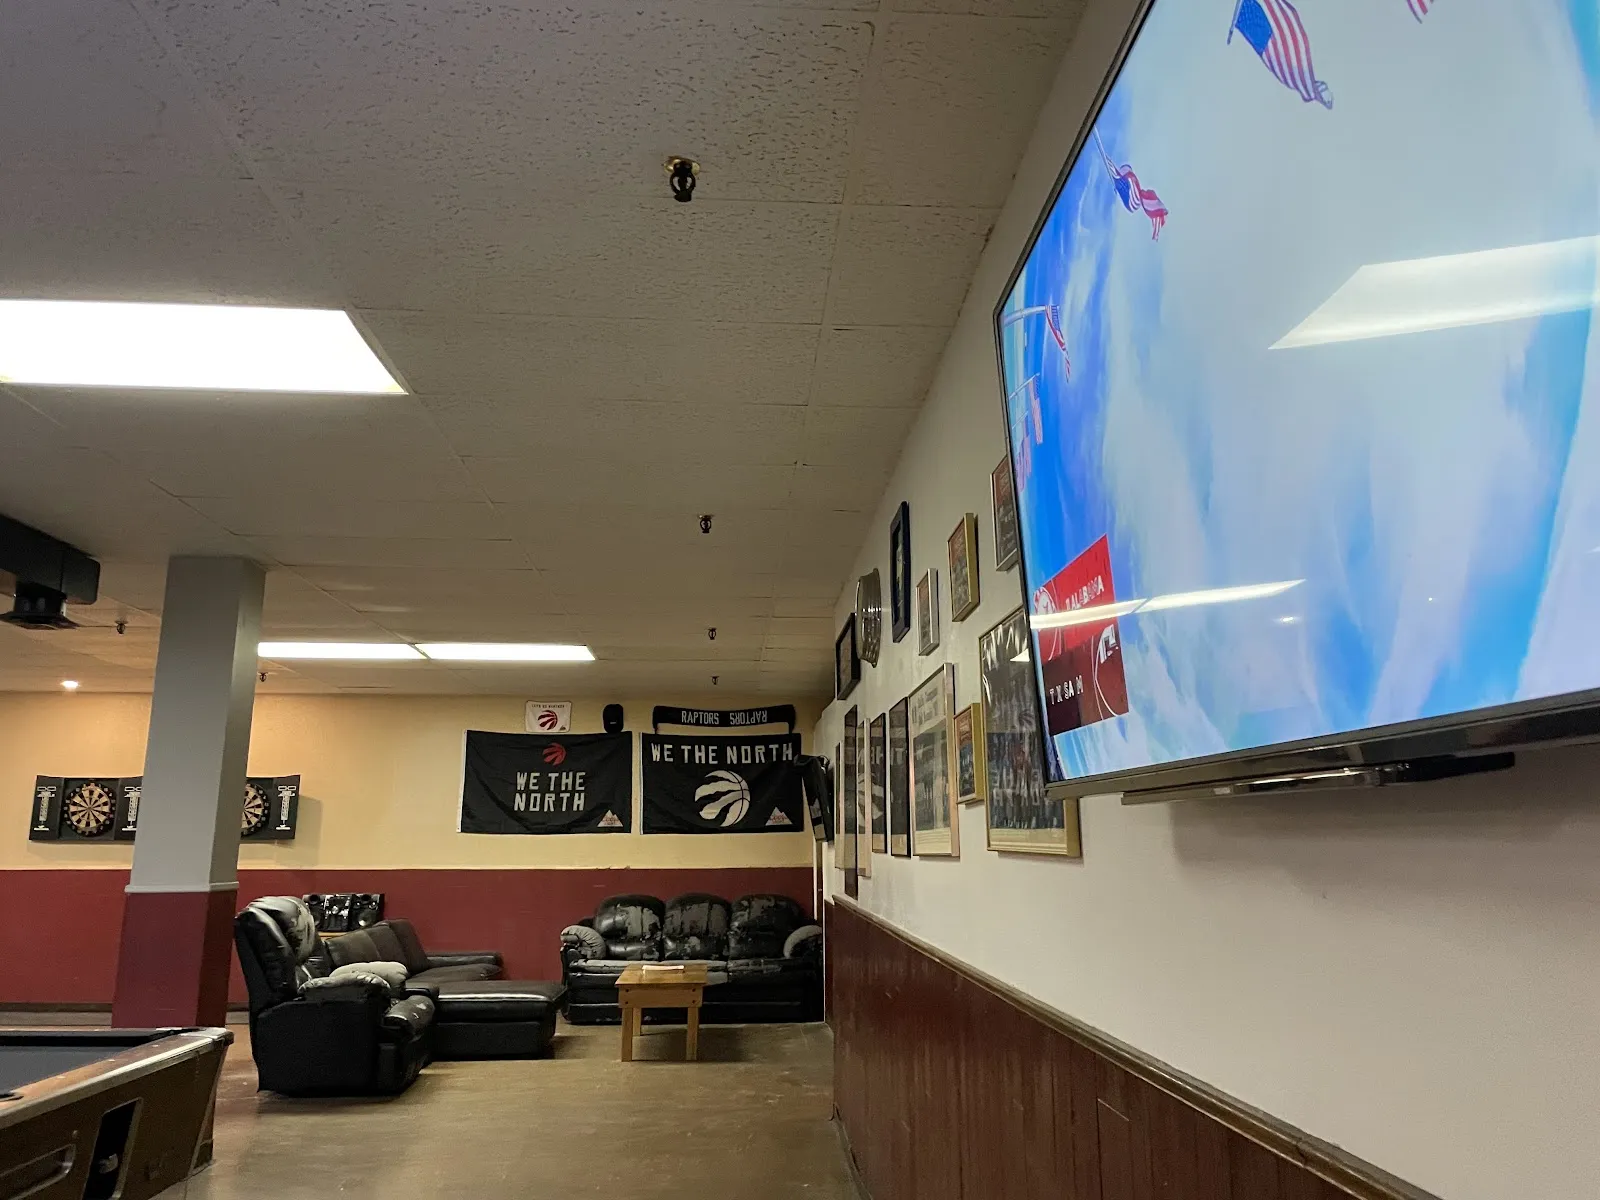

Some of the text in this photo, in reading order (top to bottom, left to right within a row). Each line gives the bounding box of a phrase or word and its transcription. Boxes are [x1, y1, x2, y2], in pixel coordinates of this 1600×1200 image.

[681, 710, 720, 725] RAPTORS
[729, 710, 768, 725] RAPTORS
[651, 742, 793, 765] WE THE NORTH
[516, 771, 586, 791] WE THE
[513, 792, 585, 812] NORTH
